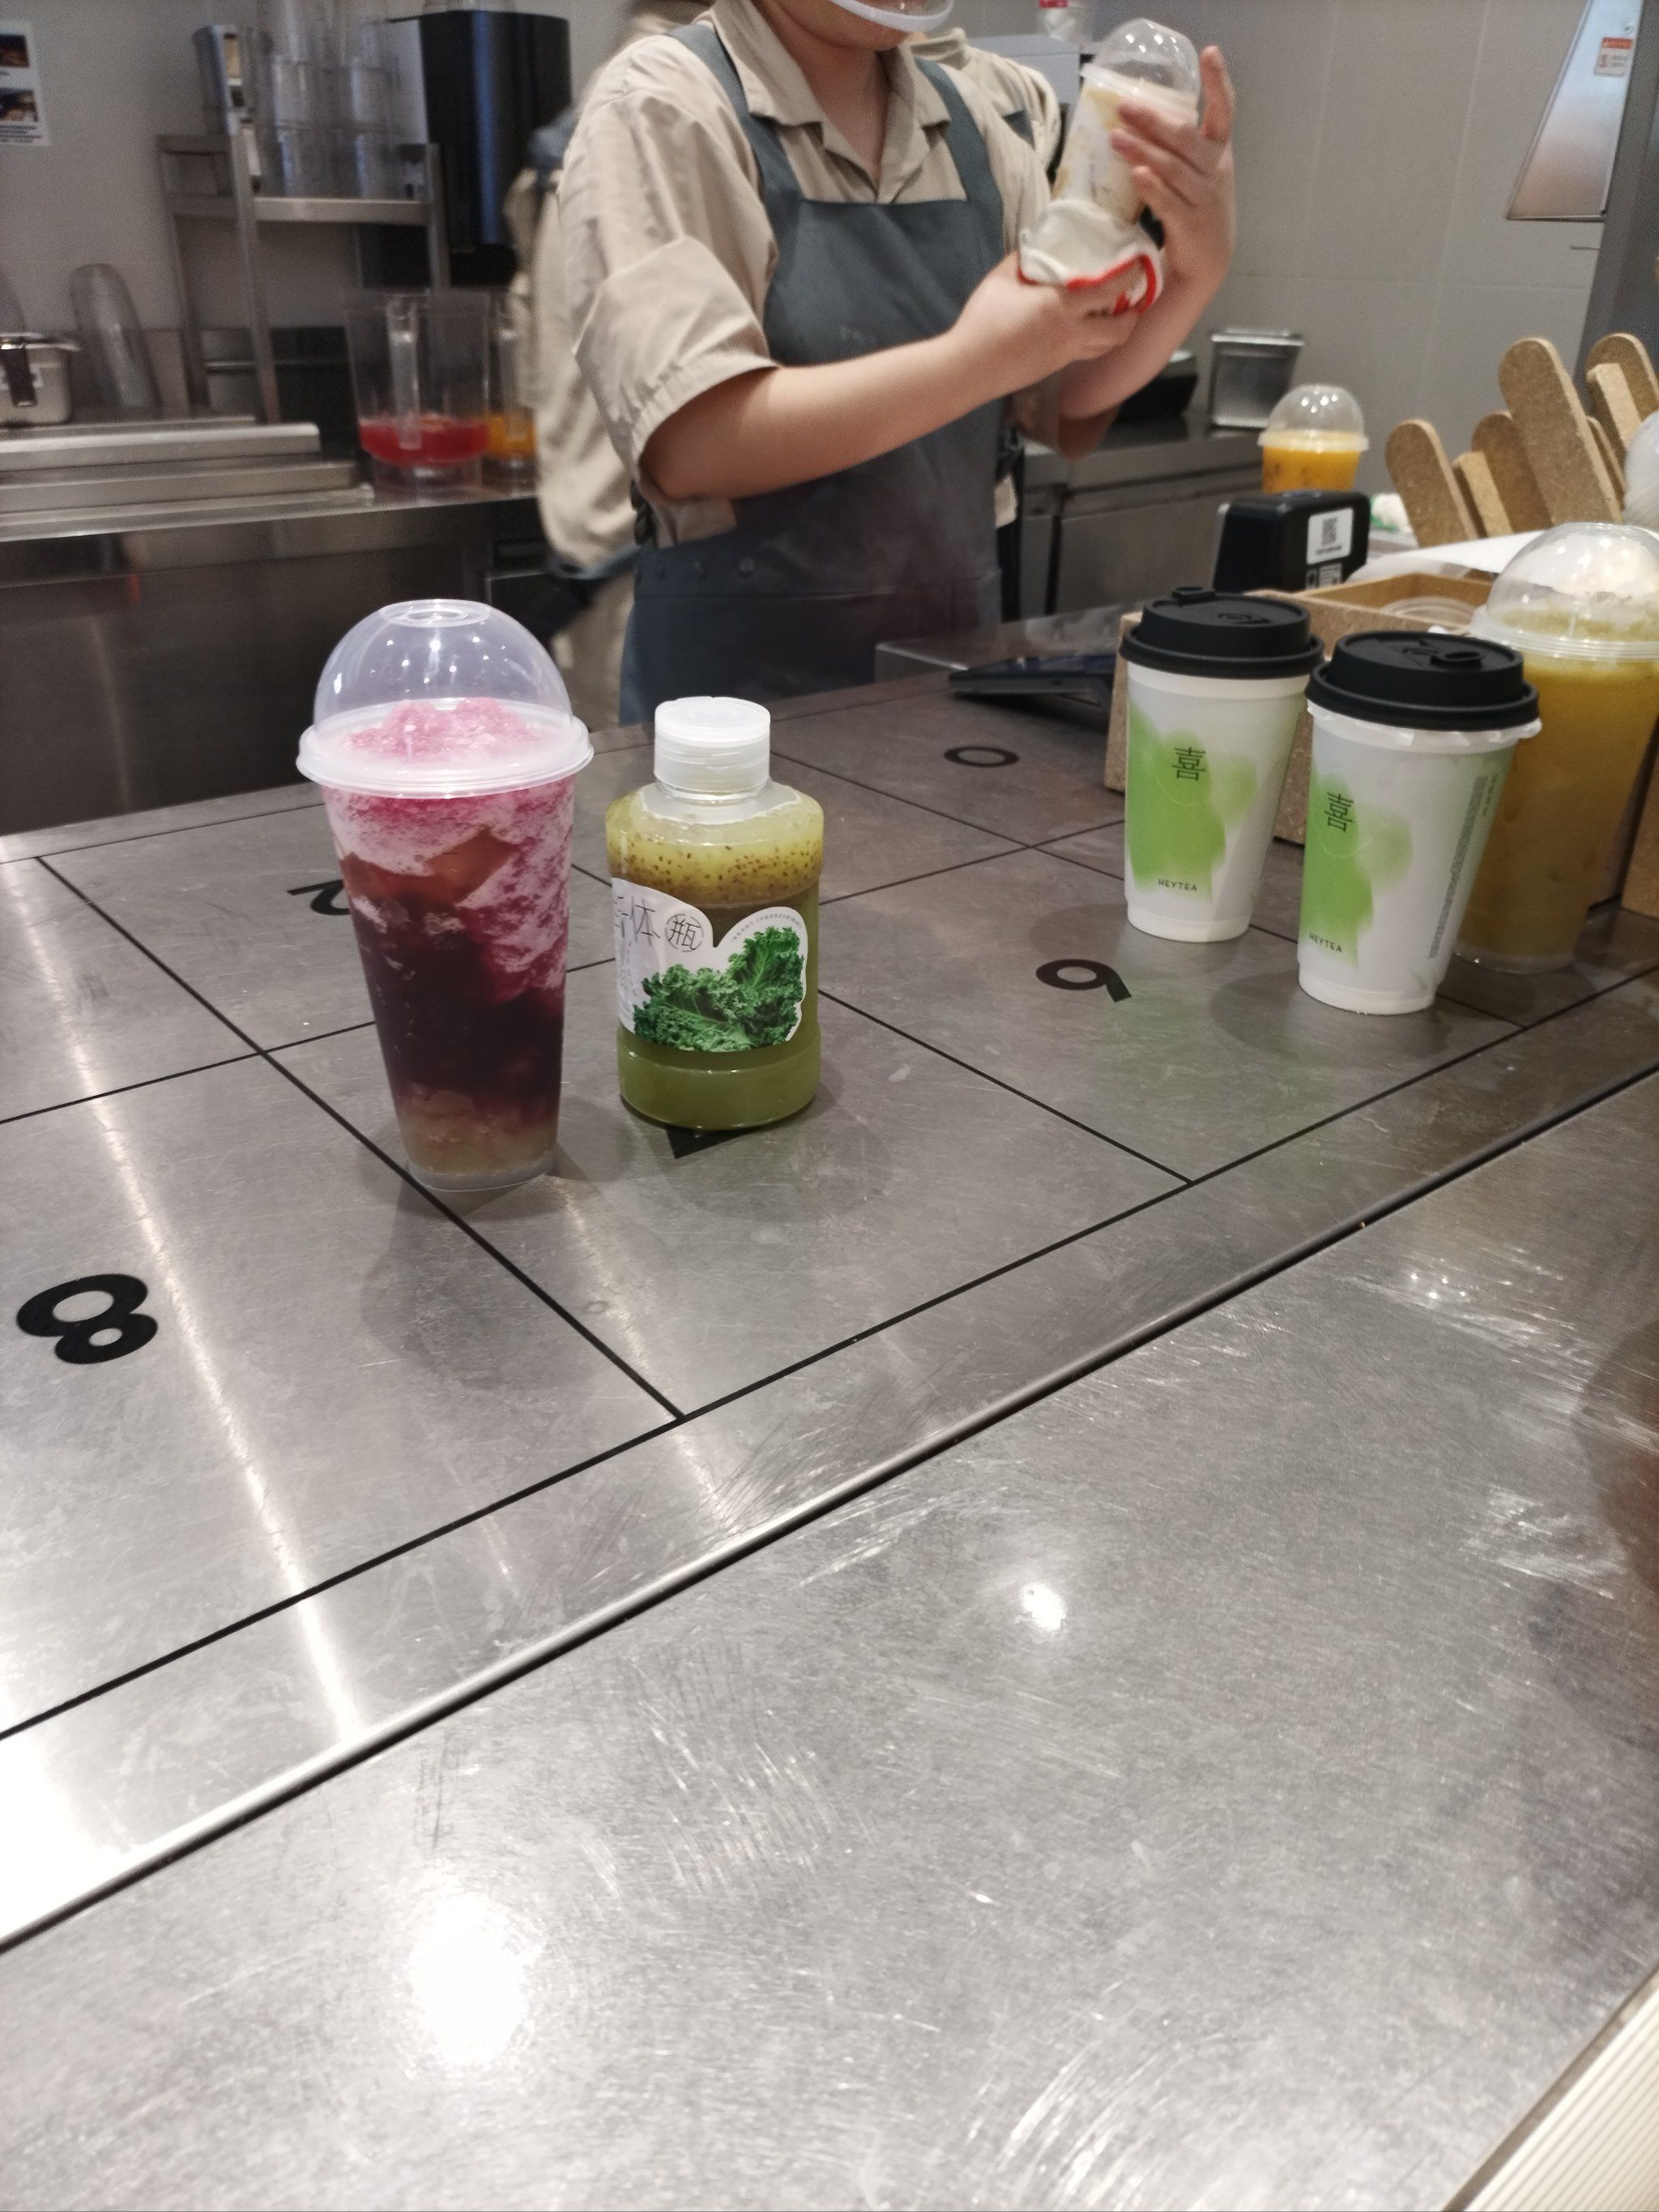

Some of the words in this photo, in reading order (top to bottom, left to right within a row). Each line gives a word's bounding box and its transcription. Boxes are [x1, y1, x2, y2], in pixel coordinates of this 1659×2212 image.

[1171, 747, 1206, 782] 喜
[1324, 792, 1354, 832] 喜
[1158, 878, 1197, 891] HEYTEA
[1309, 931, 1342, 953] HEYTEA
[16, 1273, 158, 1364] 8
